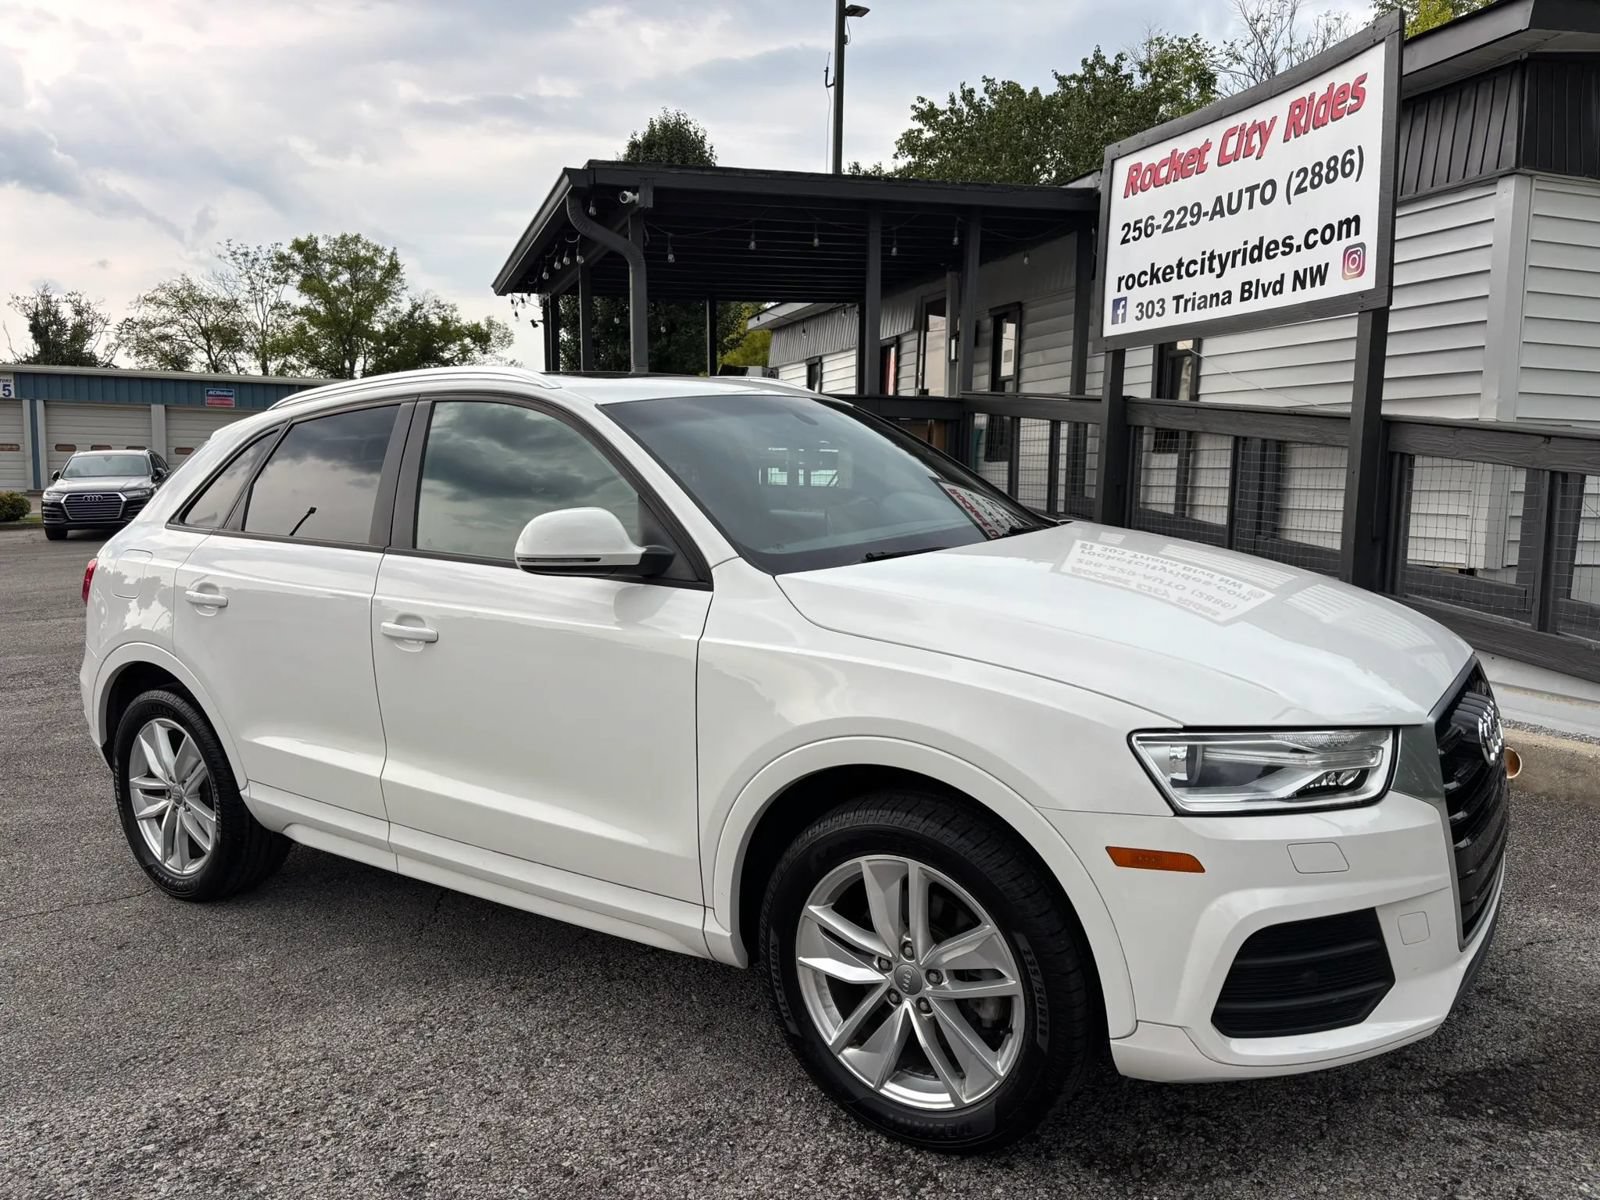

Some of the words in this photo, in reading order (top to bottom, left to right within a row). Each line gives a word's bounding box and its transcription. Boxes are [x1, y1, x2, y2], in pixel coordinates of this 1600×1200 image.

[1123, 138, 1212, 198] Rocket
[1217, 115, 1278, 167] City
[1283, 72, 1368, 142] Rides
[1119, 178, 1277, 245] 256-229-AUTO
[1285, 145, 1365, 205] (2886)
[1116, 214, 1361, 293] rocketcityrides.com
[1135, 297, 1166, 322] 303
[1172, 289, 1232, 315] Triana
[1239, 273, 1285, 303] Blvd
[1291, 262, 1330, 292] NW
[2, 383, 12, 398] 5
